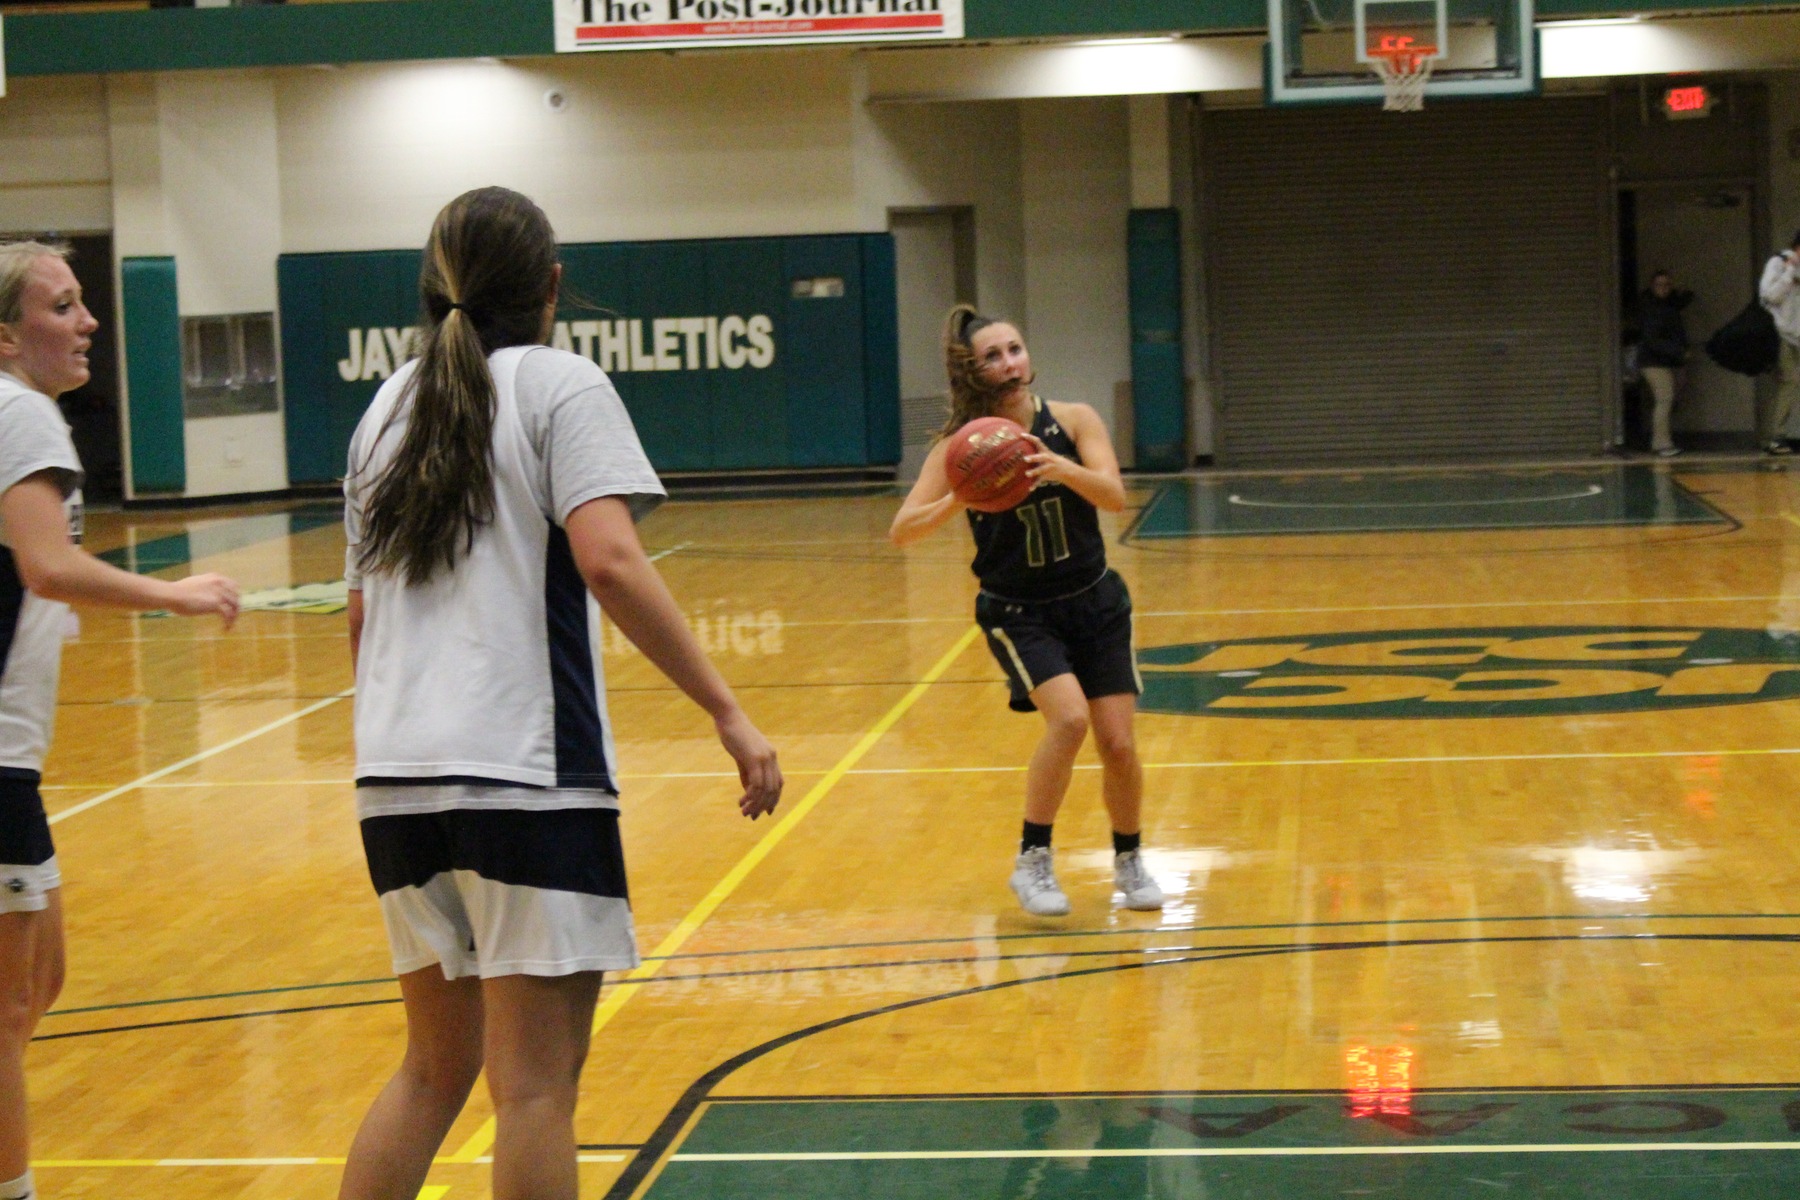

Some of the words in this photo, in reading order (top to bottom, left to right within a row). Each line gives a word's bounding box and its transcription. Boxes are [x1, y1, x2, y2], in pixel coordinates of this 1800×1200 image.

[573, 0, 652, 24] The
[552, 315, 775, 373] ATHLETICS
[1015, 497, 1071, 567] 11
[1142, 1101, 1800, 1137] CAA
